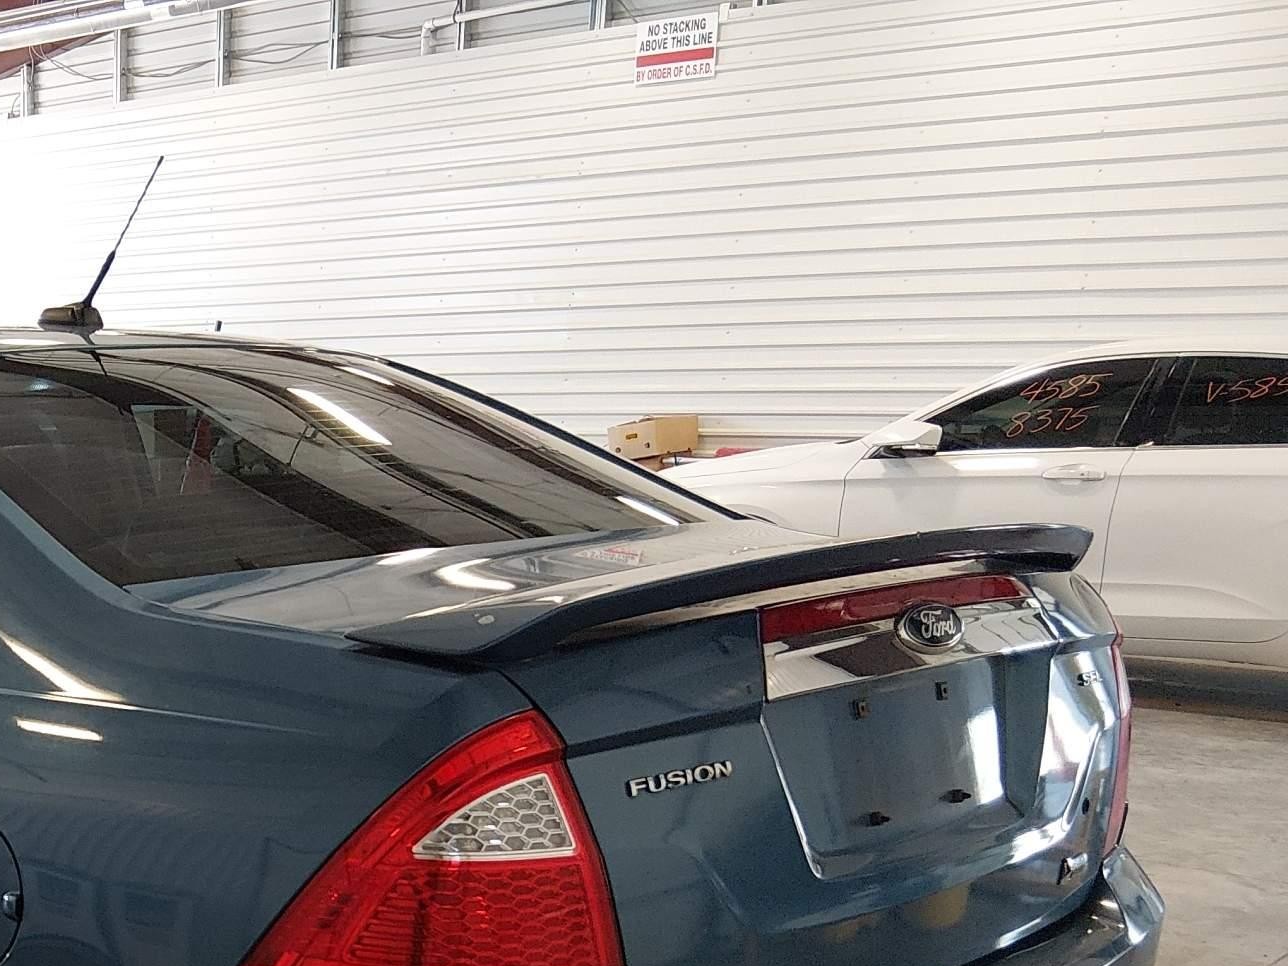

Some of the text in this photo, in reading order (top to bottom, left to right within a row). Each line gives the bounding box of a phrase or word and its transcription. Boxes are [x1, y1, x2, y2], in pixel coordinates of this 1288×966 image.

[647, 17, 707, 37] NO STACKING
[639, 31, 713, 53] ABOVE THIS LINE
[636, 62, 713, 82] BY ORDER OF C.S.F.D.
[1019, 372, 1114, 404] 4585
[1006, 404, 1101, 439] 8375
[920, 608, 957, 639] Ford
[1081, 670, 1103, 687] SEL
[627, 760, 733, 797] FUSION
